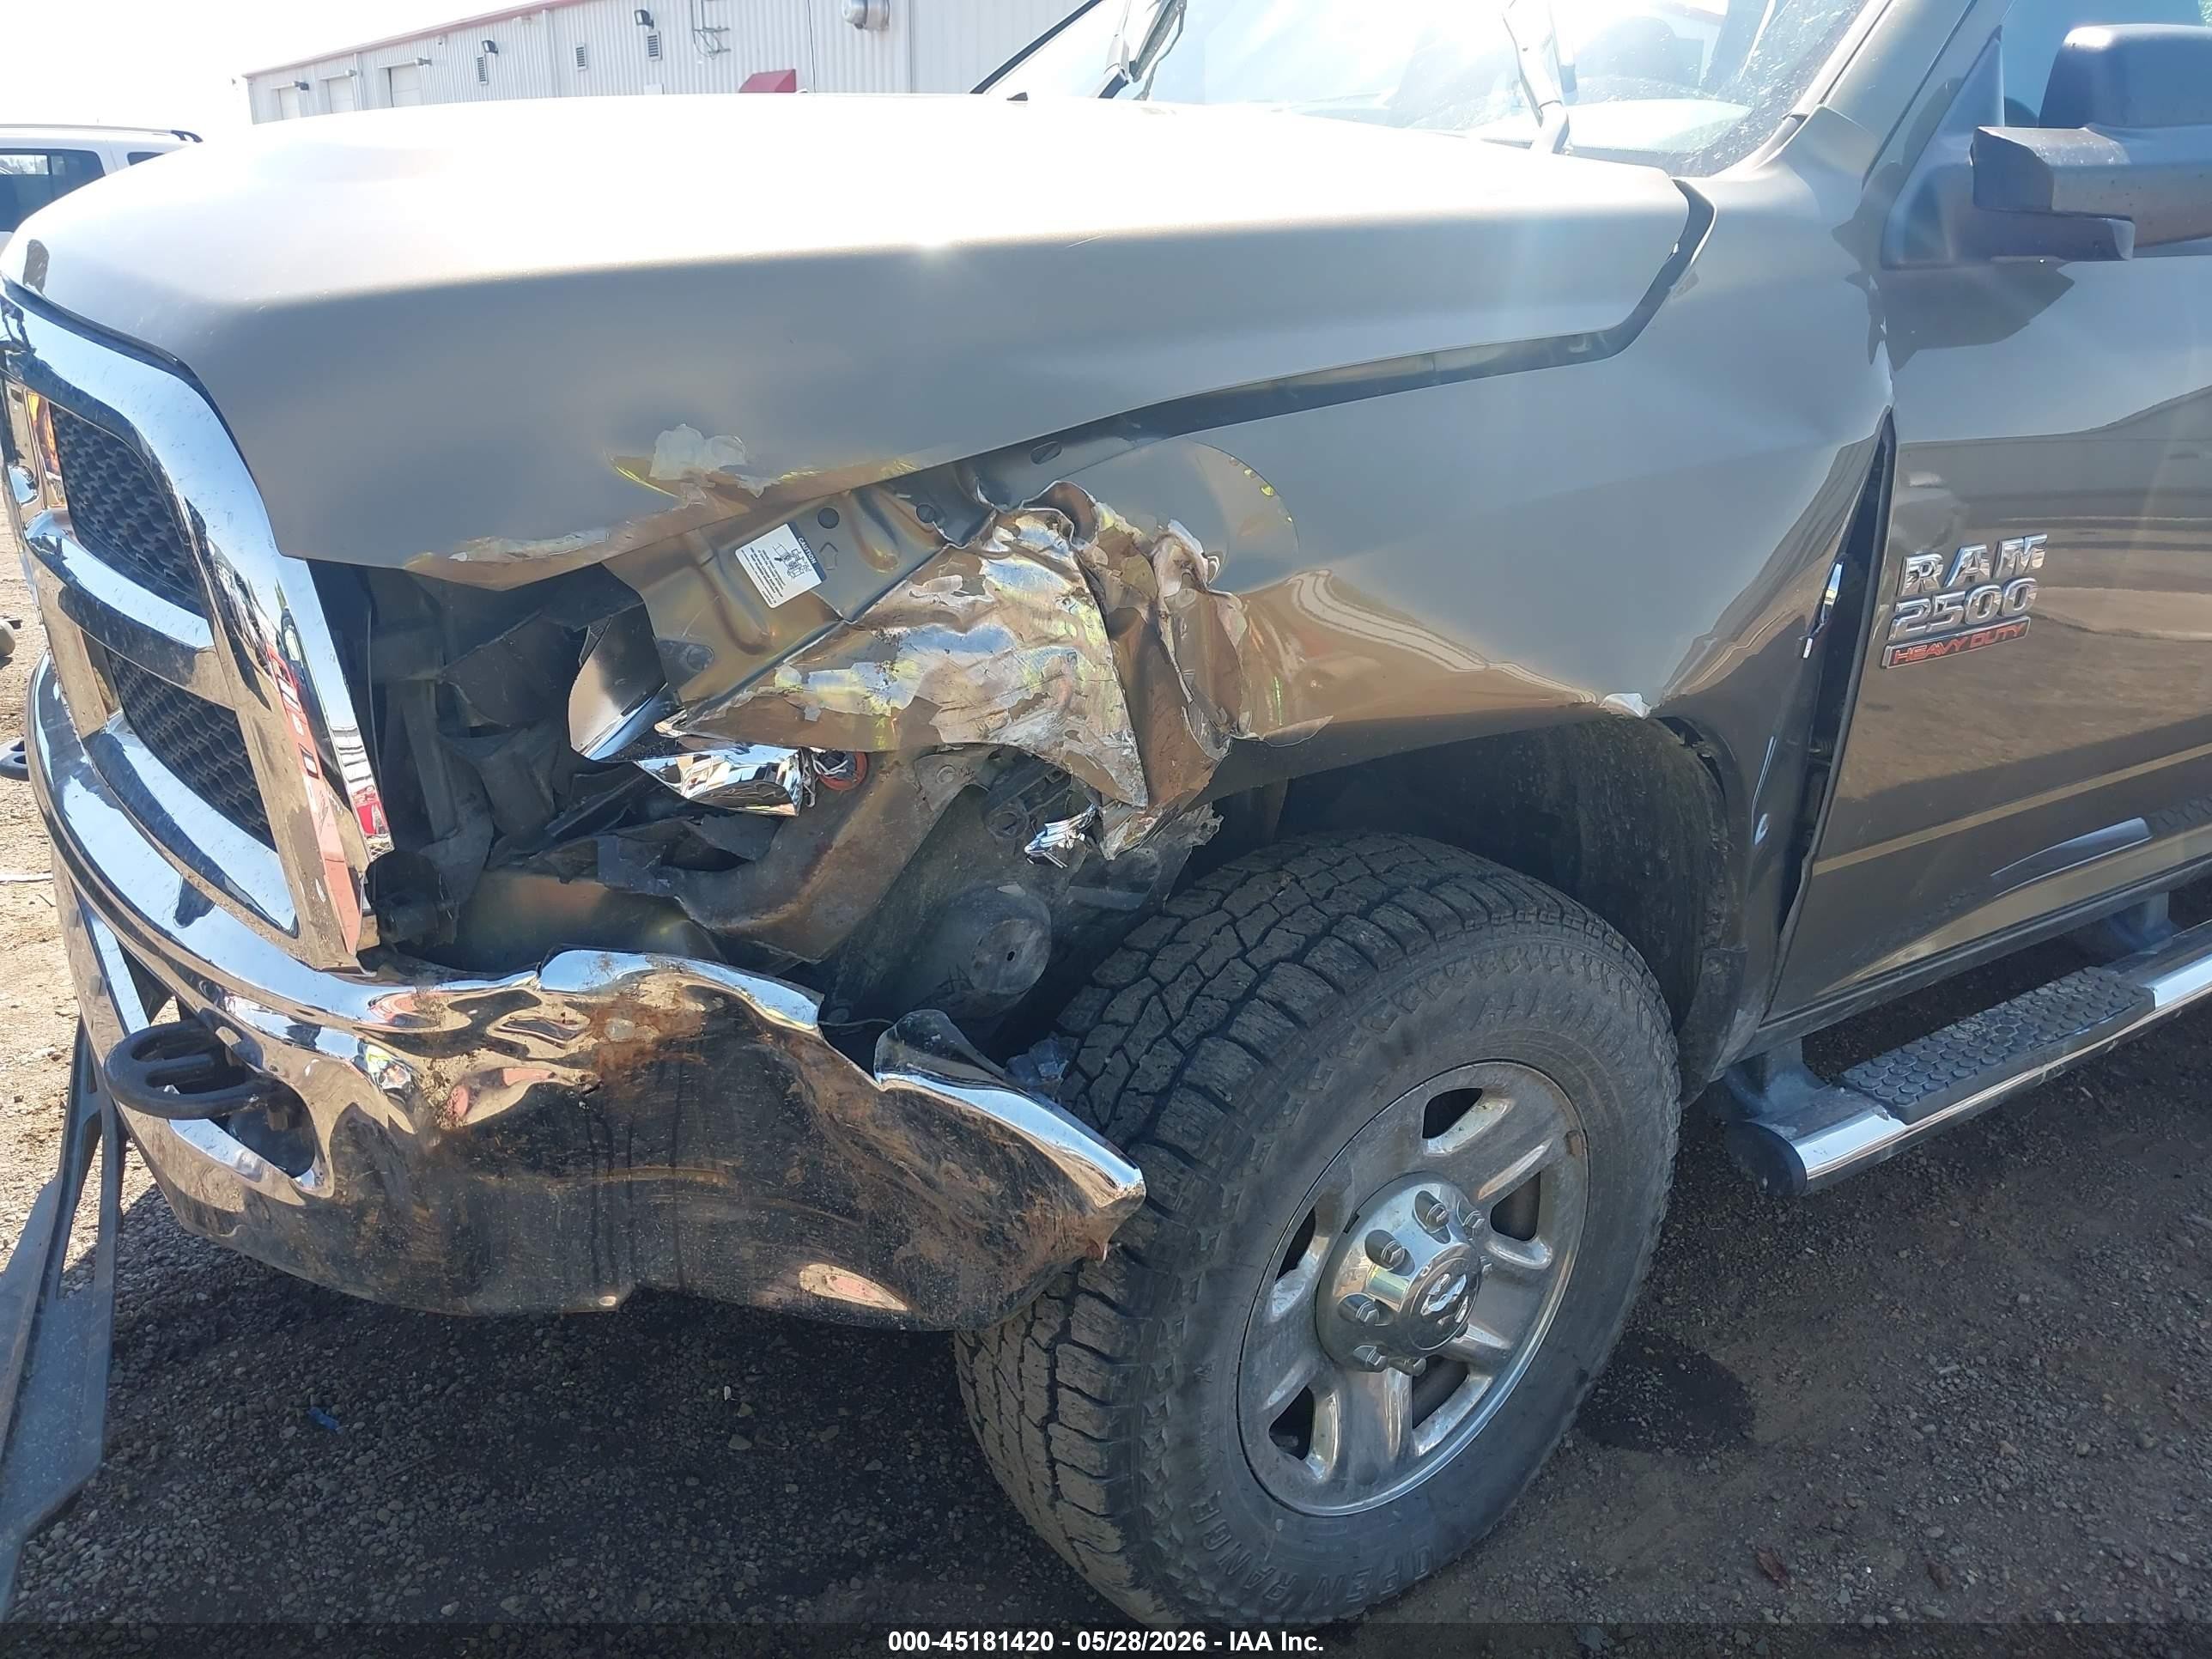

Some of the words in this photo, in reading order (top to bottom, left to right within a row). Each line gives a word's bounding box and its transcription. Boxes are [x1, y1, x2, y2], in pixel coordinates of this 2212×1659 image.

[798, 537, 817, 564] CAUTION
[1896, 533, 2048, 596] RAM
[1888, 576, 2038, 641] 2500
[1893, 636, 1968, 665] HEAVY
[1970, 623, 2026, 650] DUTY
[1189, 1492, 1299, 1602] RANGE
